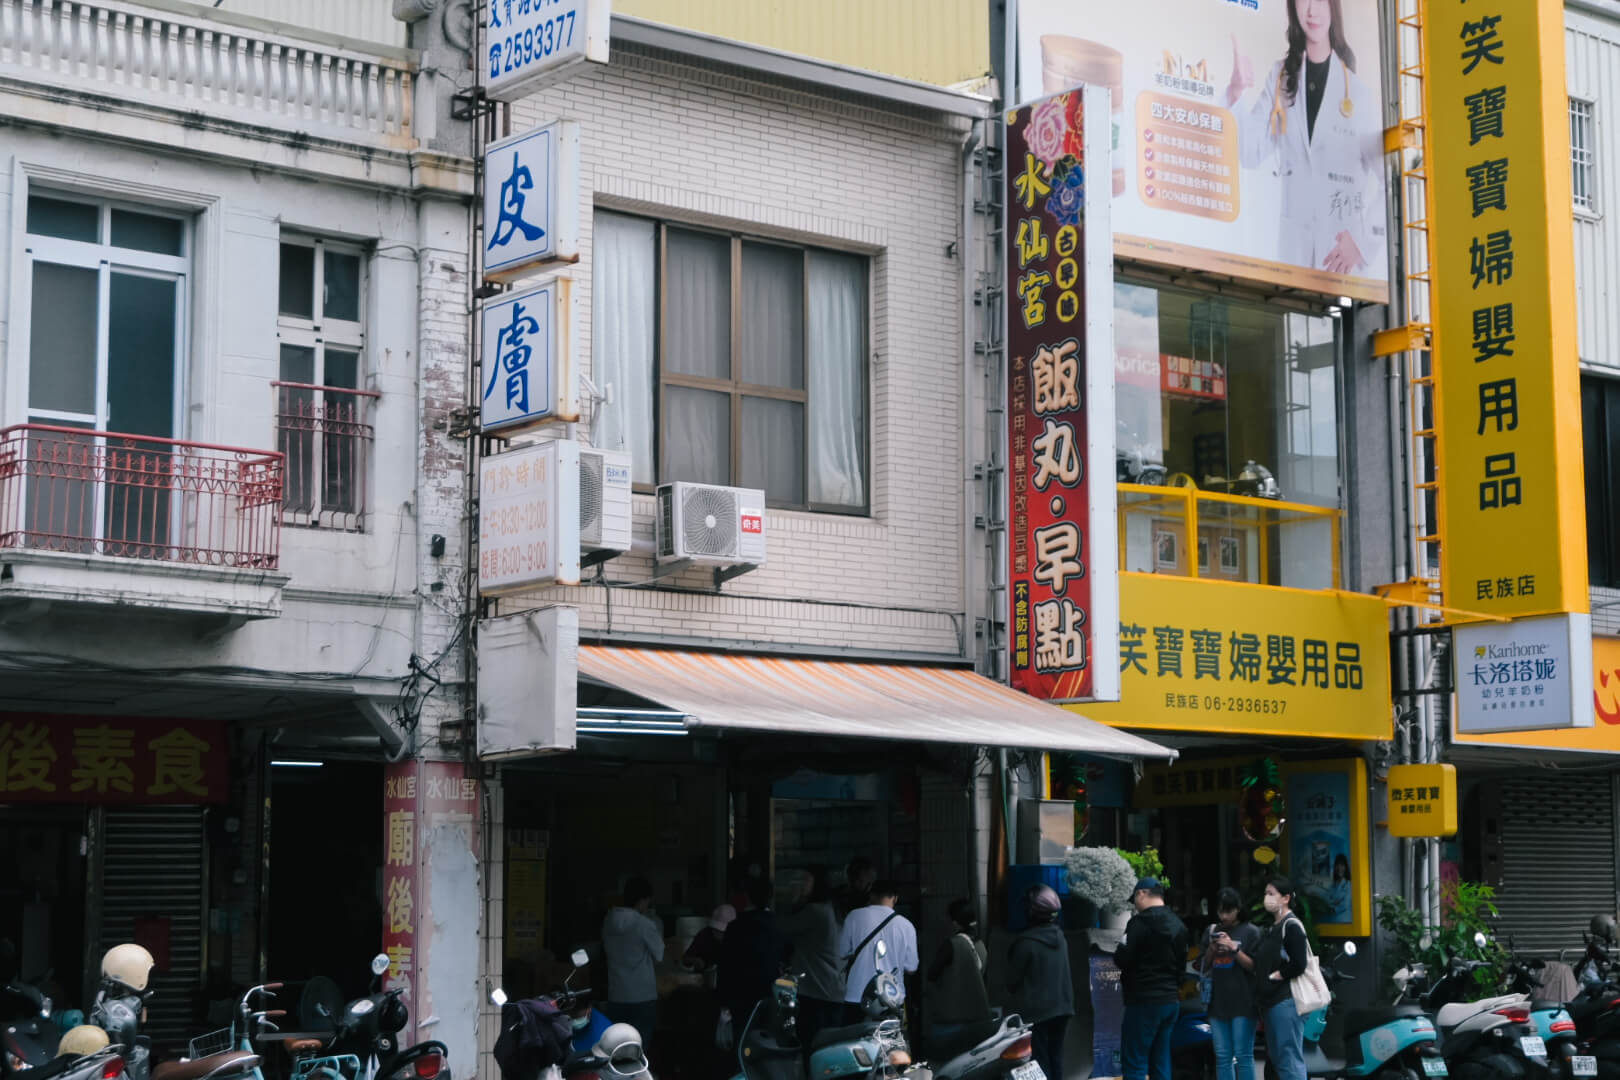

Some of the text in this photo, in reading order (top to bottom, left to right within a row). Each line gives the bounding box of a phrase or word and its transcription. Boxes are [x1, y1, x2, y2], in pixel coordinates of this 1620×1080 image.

[504, 10, 576, 73] 2593377
[487, 151, 546, 250] 皮
[1015, 153, 1051, 328] 水仙宮
[1459, 0, 1522, 511] 笑寶寶婦嬰用品
[485, 302, 540, 414] 膚
[1476, 575, 1536, 600] 民族店
[1467, 658, 1556, 686] 卡洛塔妮
[1165, 693, 1287, 716] 民族店 06-2936537
[1482, 684, 1545, 699] 幼兒羊奶粉
[387, 775, 417, 799] 水仙宮
[425, 776, 477, 801] 水仙宮
